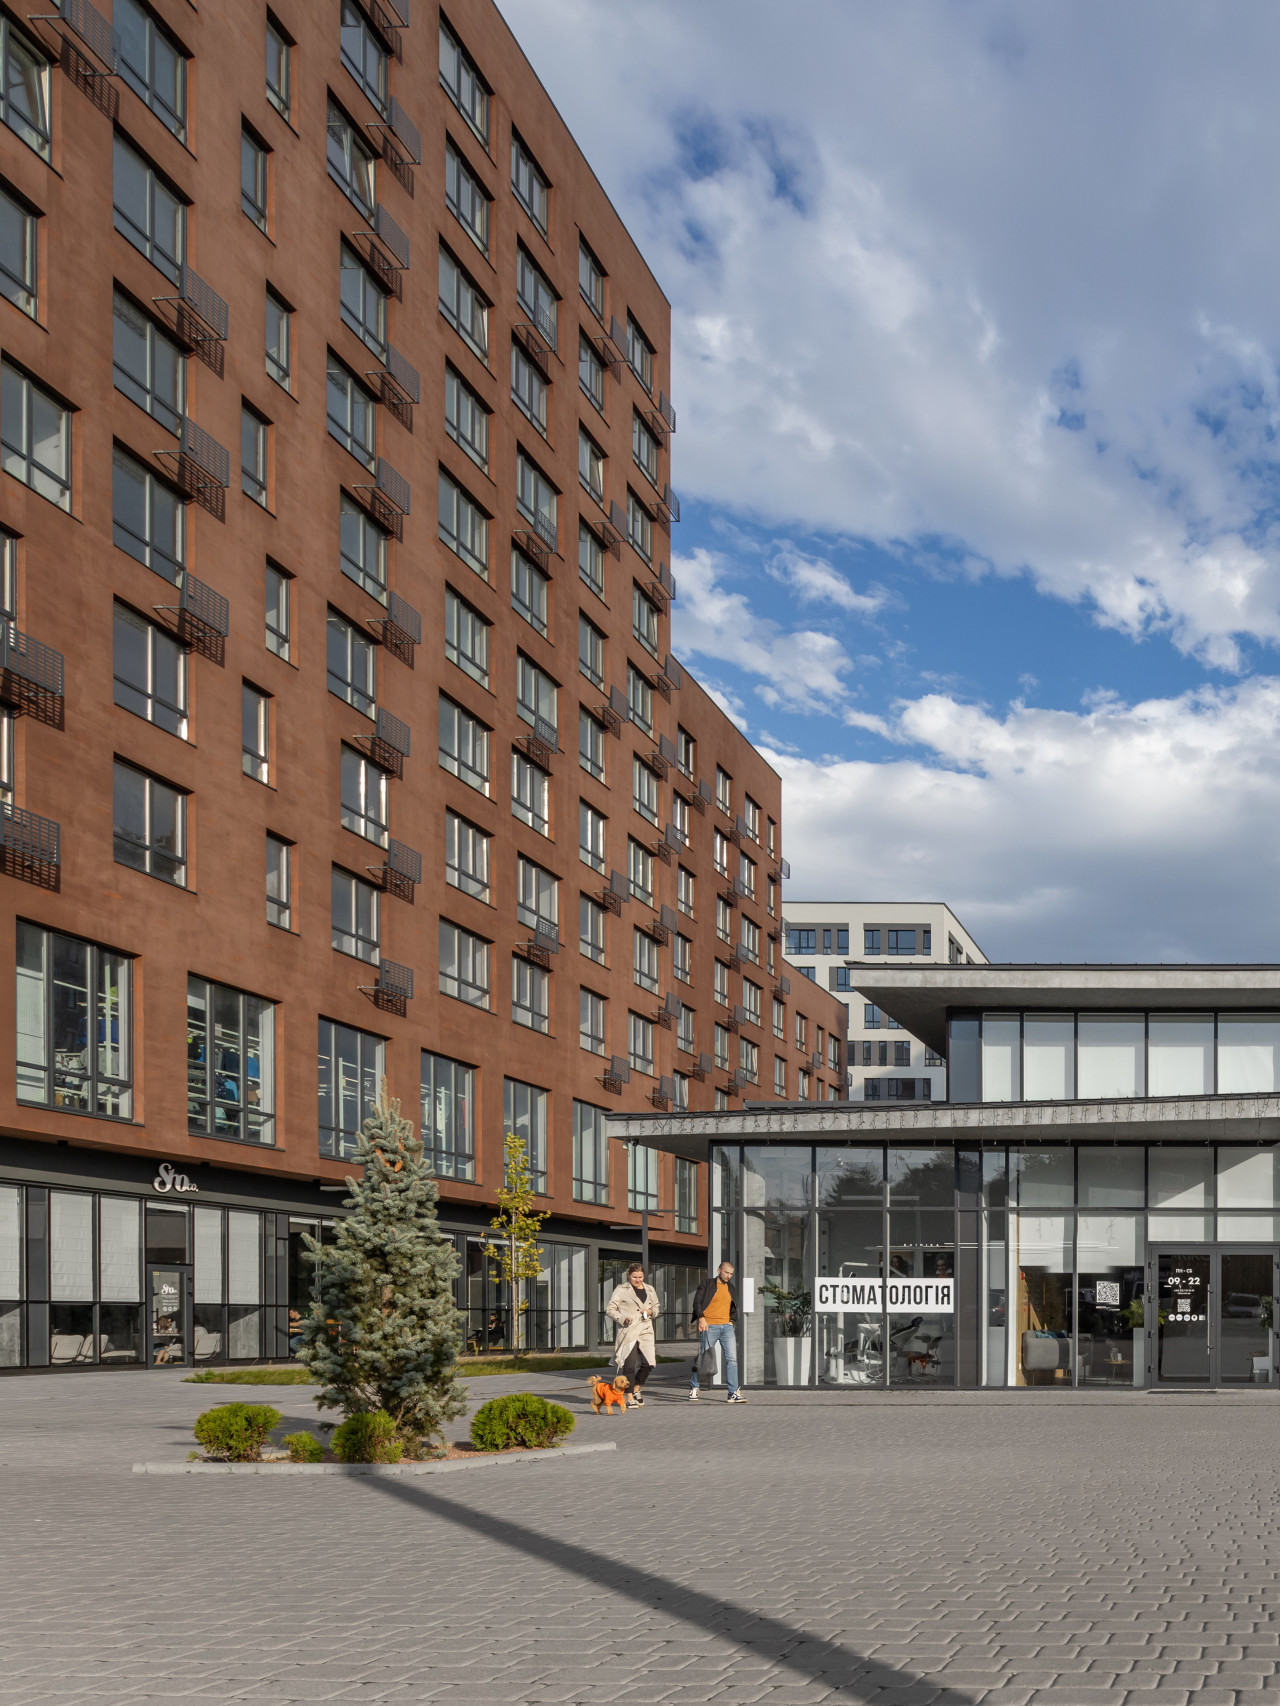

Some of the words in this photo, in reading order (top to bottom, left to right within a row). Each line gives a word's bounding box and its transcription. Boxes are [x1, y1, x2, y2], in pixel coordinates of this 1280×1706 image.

[1167, 1277, 1181, 1285] 09
[1188, 1277, 1201, 1285] 22
[819, 1284, 951, 1305] СТОМАТОЛОГІЯ
